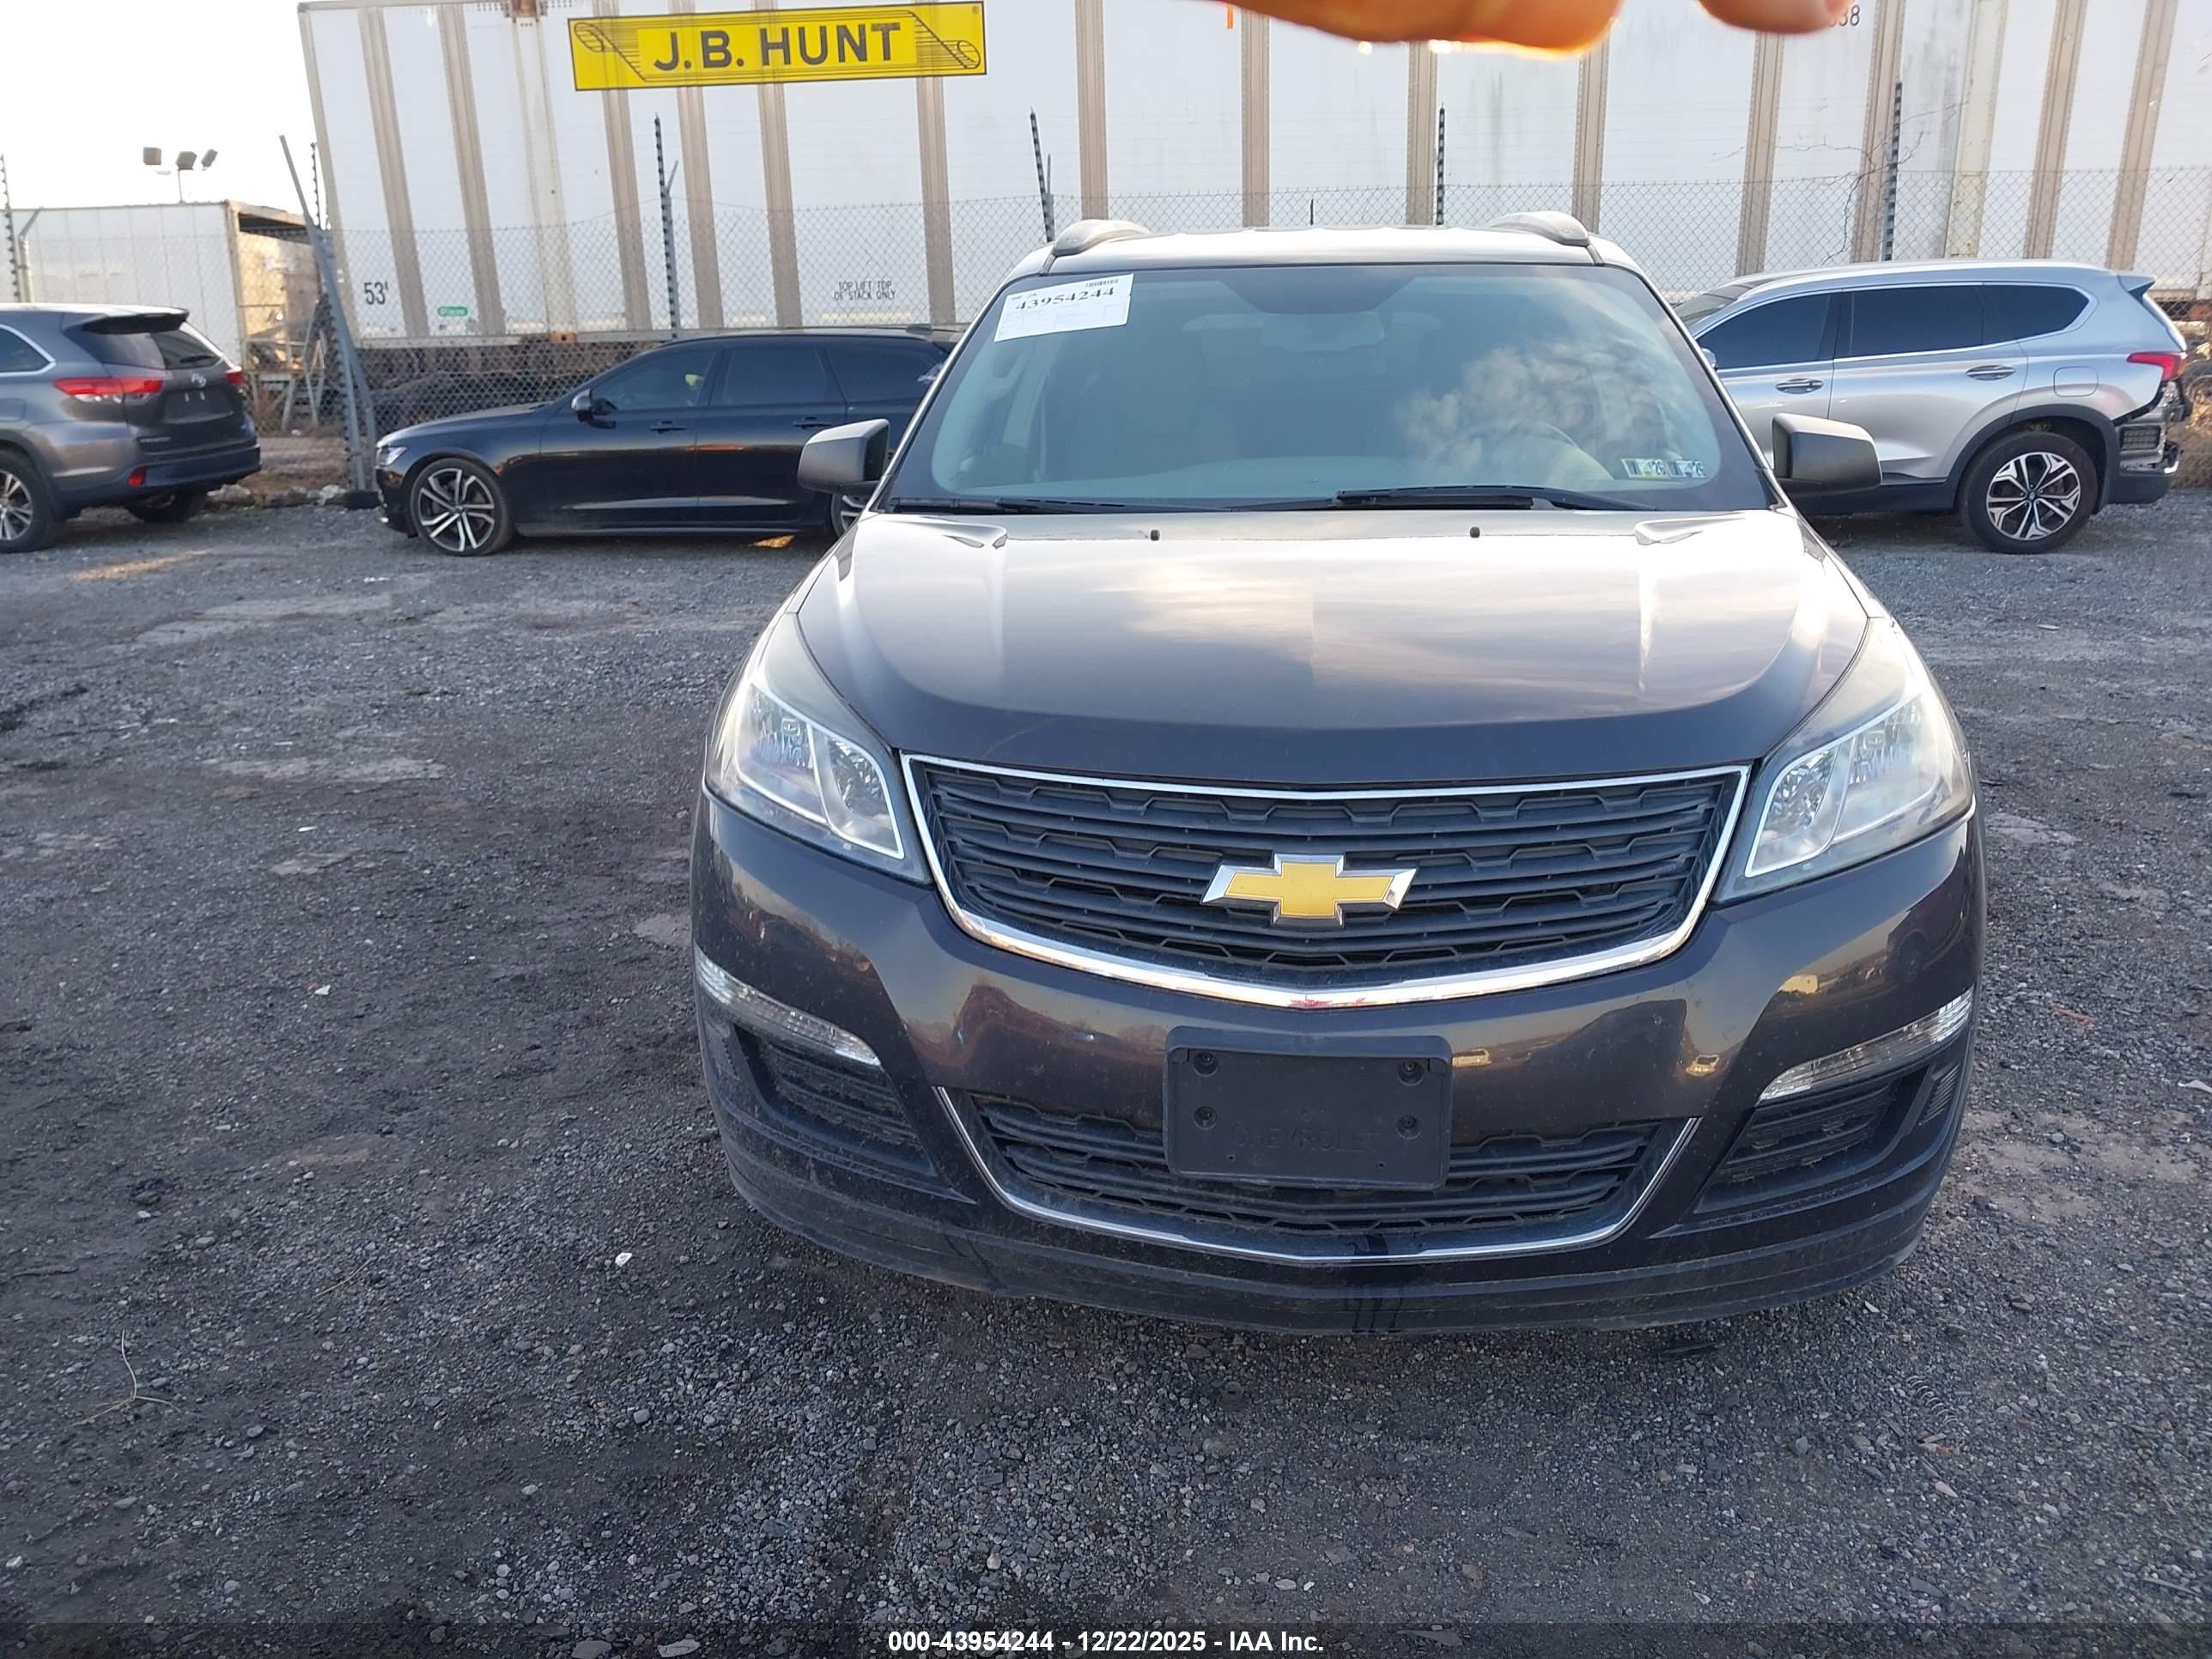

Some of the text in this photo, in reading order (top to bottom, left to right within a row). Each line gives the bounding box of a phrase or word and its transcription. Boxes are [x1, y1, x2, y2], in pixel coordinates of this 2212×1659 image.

[653, 22, 901, 70] J.B. HUNT
[834, 289, 896, 301] OF STACK ONLY
[838, 281, 854, 291] TOP
[878, 280, 892, 290] TOP
[1015, 287, 1115, 310] 43954244
[1231, 1123, 1382, 1153] CHEVROLET
